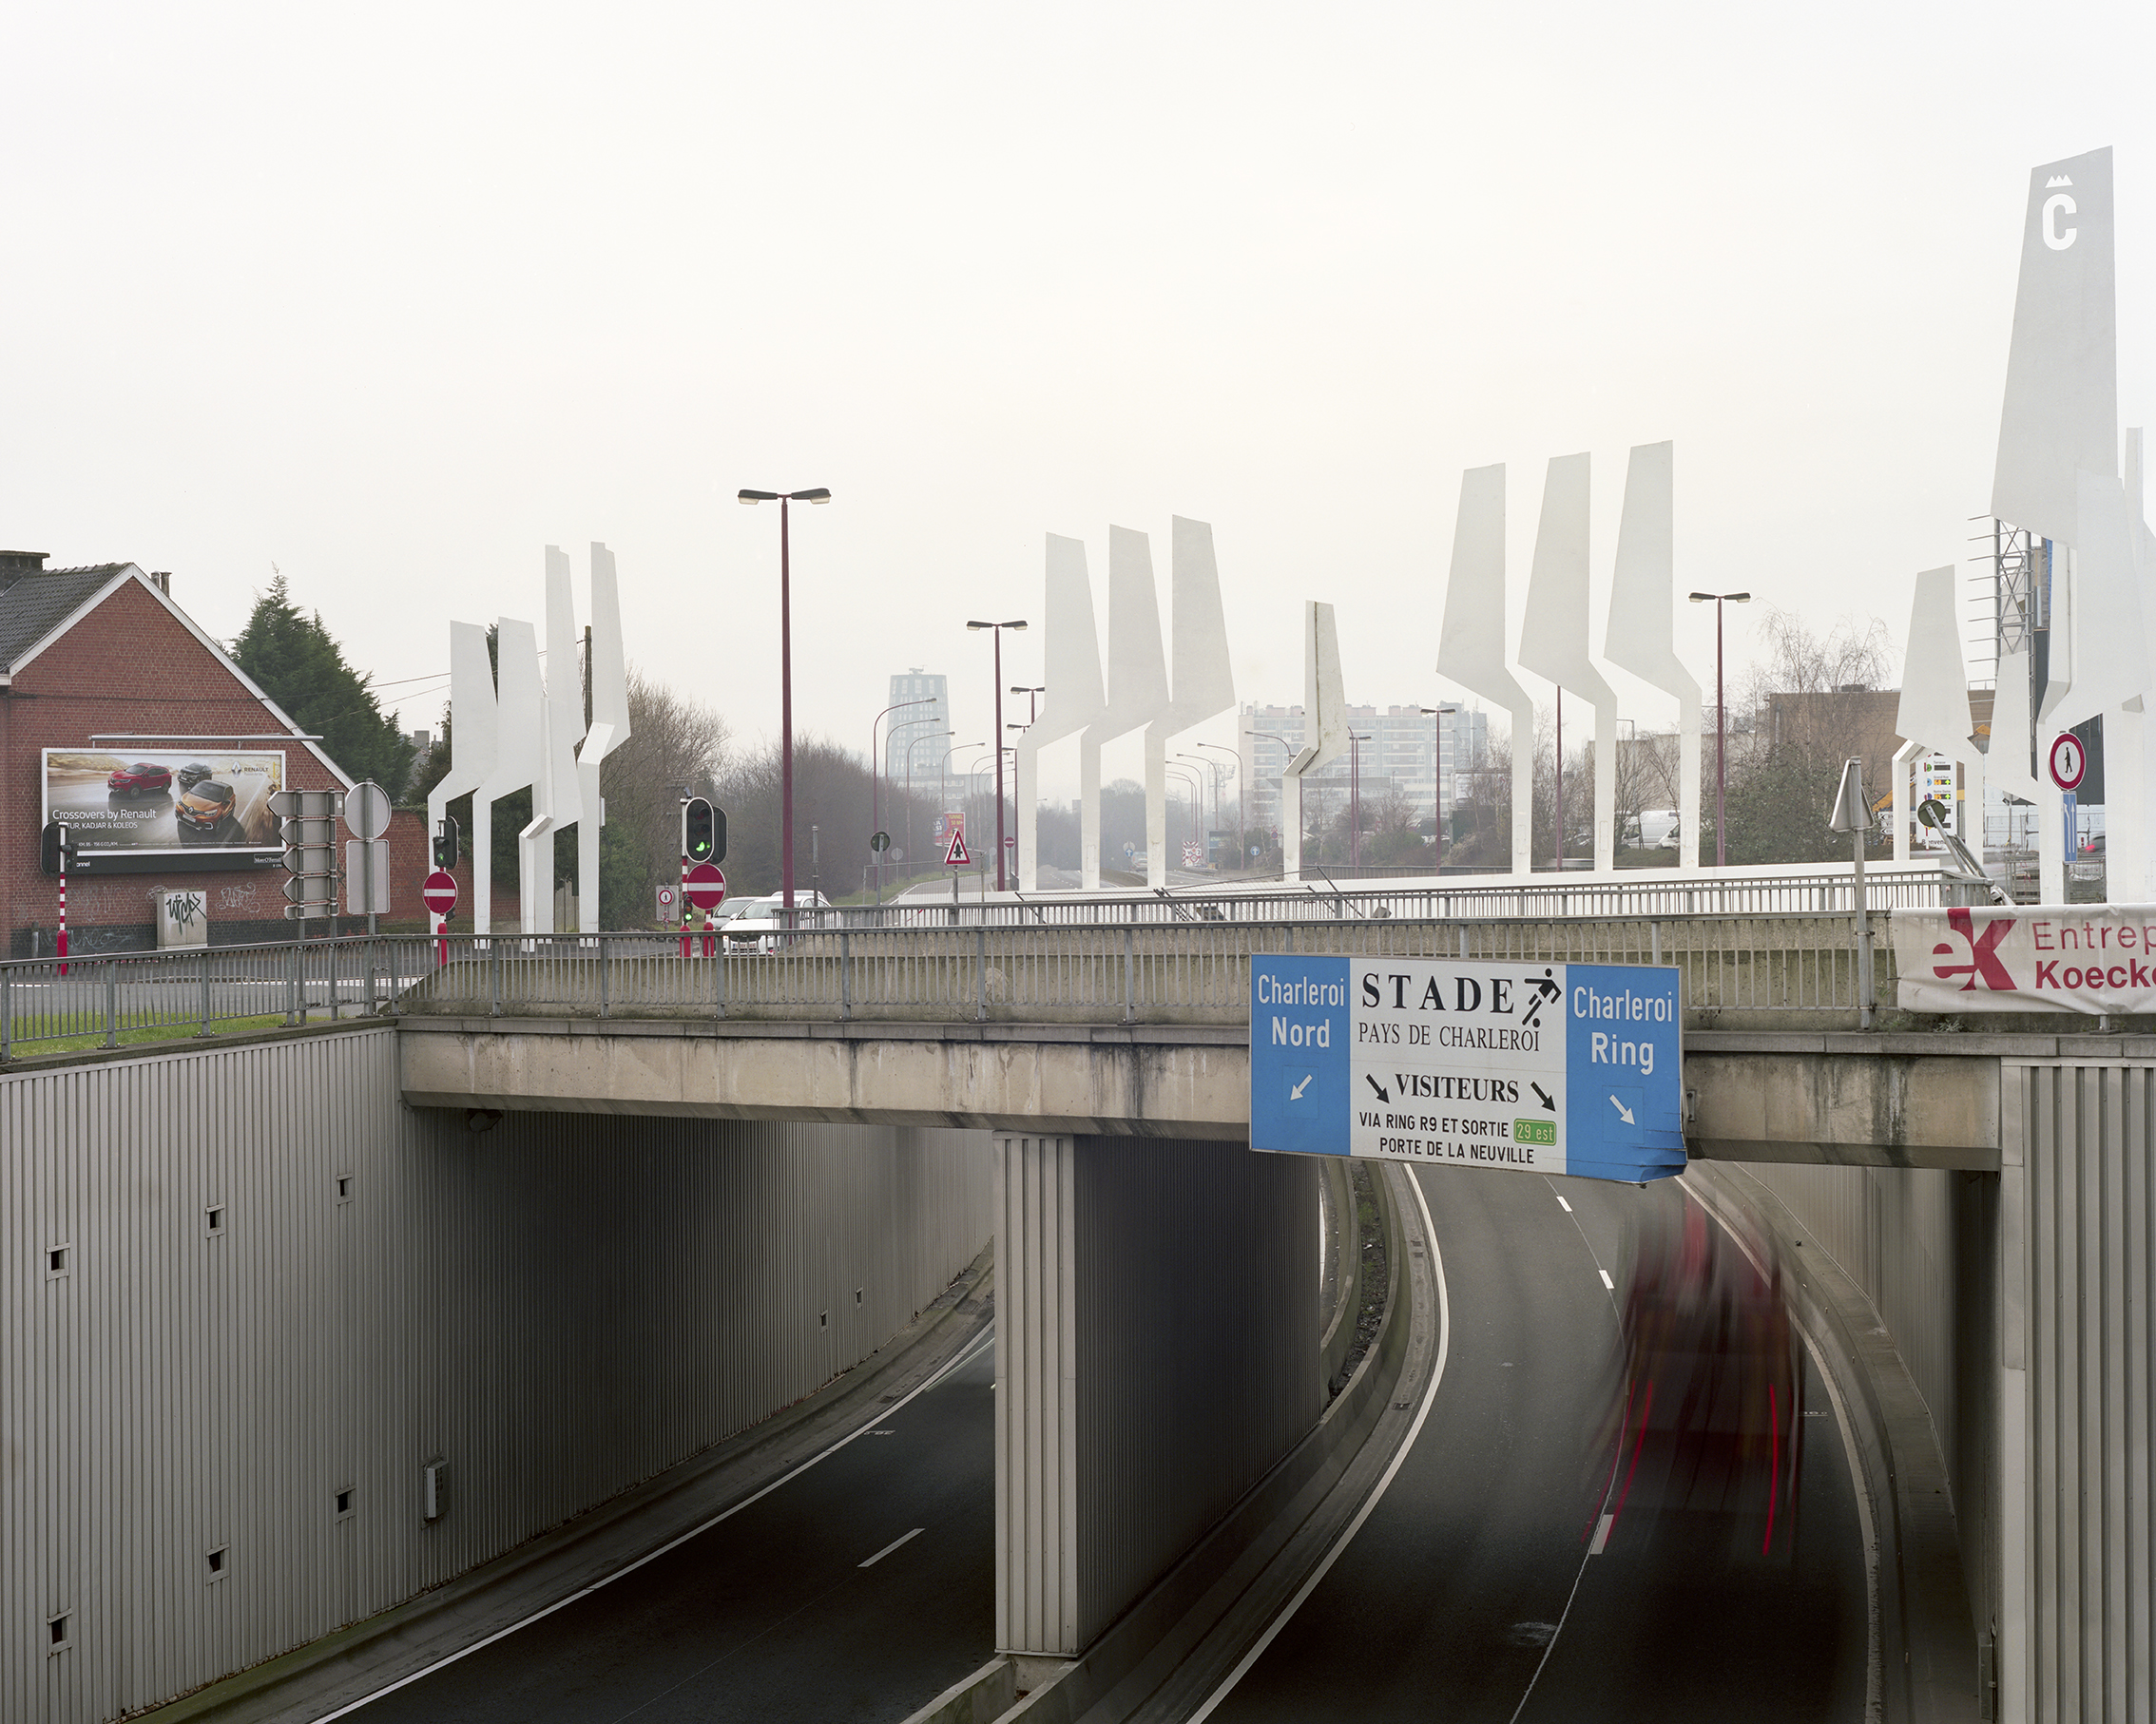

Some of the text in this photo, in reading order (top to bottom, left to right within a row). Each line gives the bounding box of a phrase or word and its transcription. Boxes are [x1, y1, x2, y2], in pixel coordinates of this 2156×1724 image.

[52, 809, 157, 821] Crossovers by Renault
[2035, 958, 2156, 989] Koeck
[1258, 974, 1344, 1006] Charleroi
[1362, 972, 1514, 1014] STADE
[1573, 986, 1672, 1023] Charleroi
[1272, 1016, 1330, 1048] Nord
[1358, 1022, 1540, 1052] PAYS DE CHARLEROI
[1591, 1032, 1654, 1076] Ring
[1395, 1073, 1519, 1103] VISITEURS
[1359, 1112, 1509, 1138] VIA RING R9 ET SORTIE
[1516, 1123, 1553, 1141] 29 est
[1380, 1138, 1534, 1164] PORTE DE LA NEUVILLE
